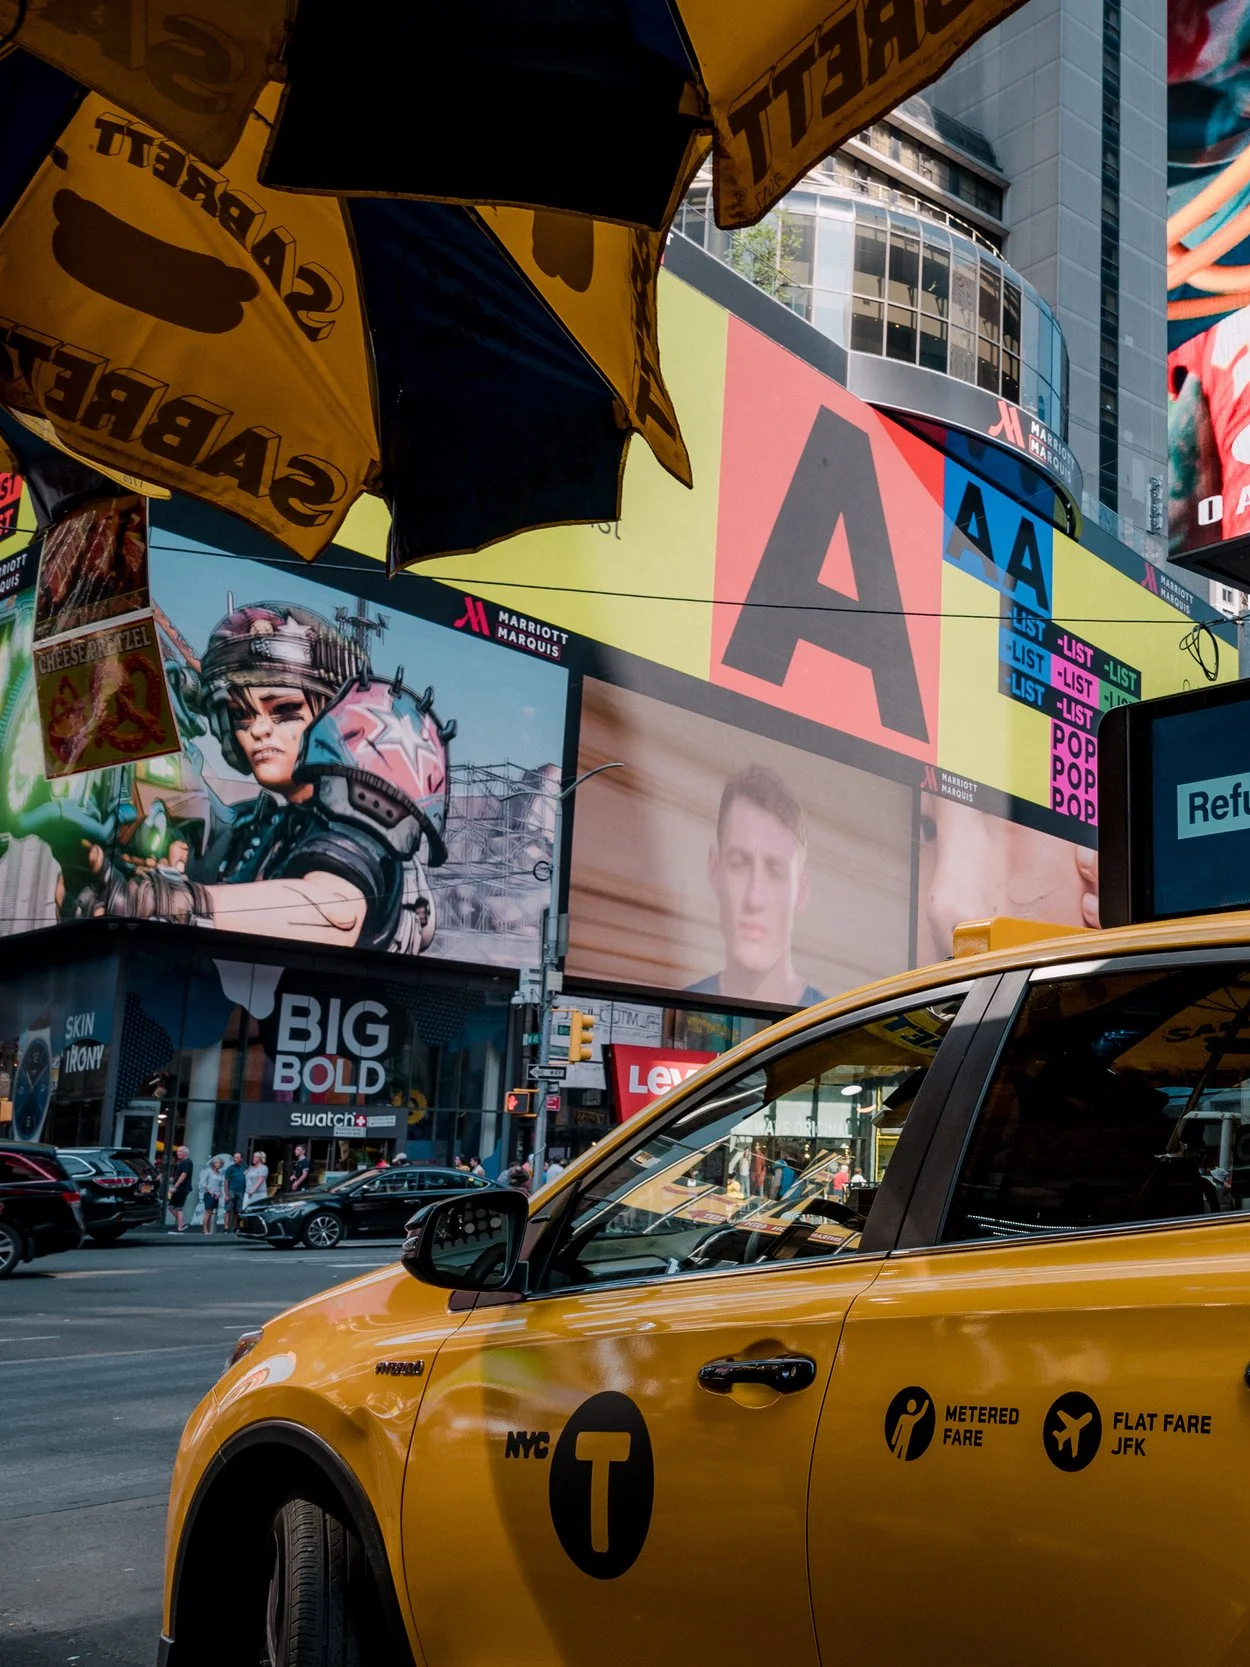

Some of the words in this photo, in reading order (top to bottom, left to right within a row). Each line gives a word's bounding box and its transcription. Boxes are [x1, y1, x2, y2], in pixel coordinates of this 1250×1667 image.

[1031, 421, 1075, 469] MARRIOTT
[1031, 440, 1072, 484] MARQUIS
[720, 404, 931, 745] A
[1160, 575, 1194, 604] MARRIOTT
[1160, 587, 1191, 614] MARQUIS
[498, 627, 560, 658] MARQUIS
[499, 611, 569, 645] MARRIOTT
[1053, 722, 1096, 764] POP
[941, 773, 977, 793] MARRIOTT
[1053, 754, 1096, 795] POP
[941, 784, 974, 803] MARQUIS
[1053, 785, 1096, 823] POP
[65, 1011, 95, 1039] SKIN
[278, 994, 390, 1058] BIG
[65, 1044, 105, 1073] IRONY
[533, 1069, 544, 1077] ONE
[273, 1055, 386, 1095] BOLD
[290, 1111, 357, 1127] swatch
[945, 1405, 1020, 1425] METERED
[1113, 1411, 1158, 1432] FLAT
[1163, 1413, 1212, 1434] FARE
[943, 1428, 983, 1447] FARE
[1111, 1437, 1146, 1457] JFK
[505, 1431, 551, 1460] NYC
[575, 1431, 631, 1553] T
